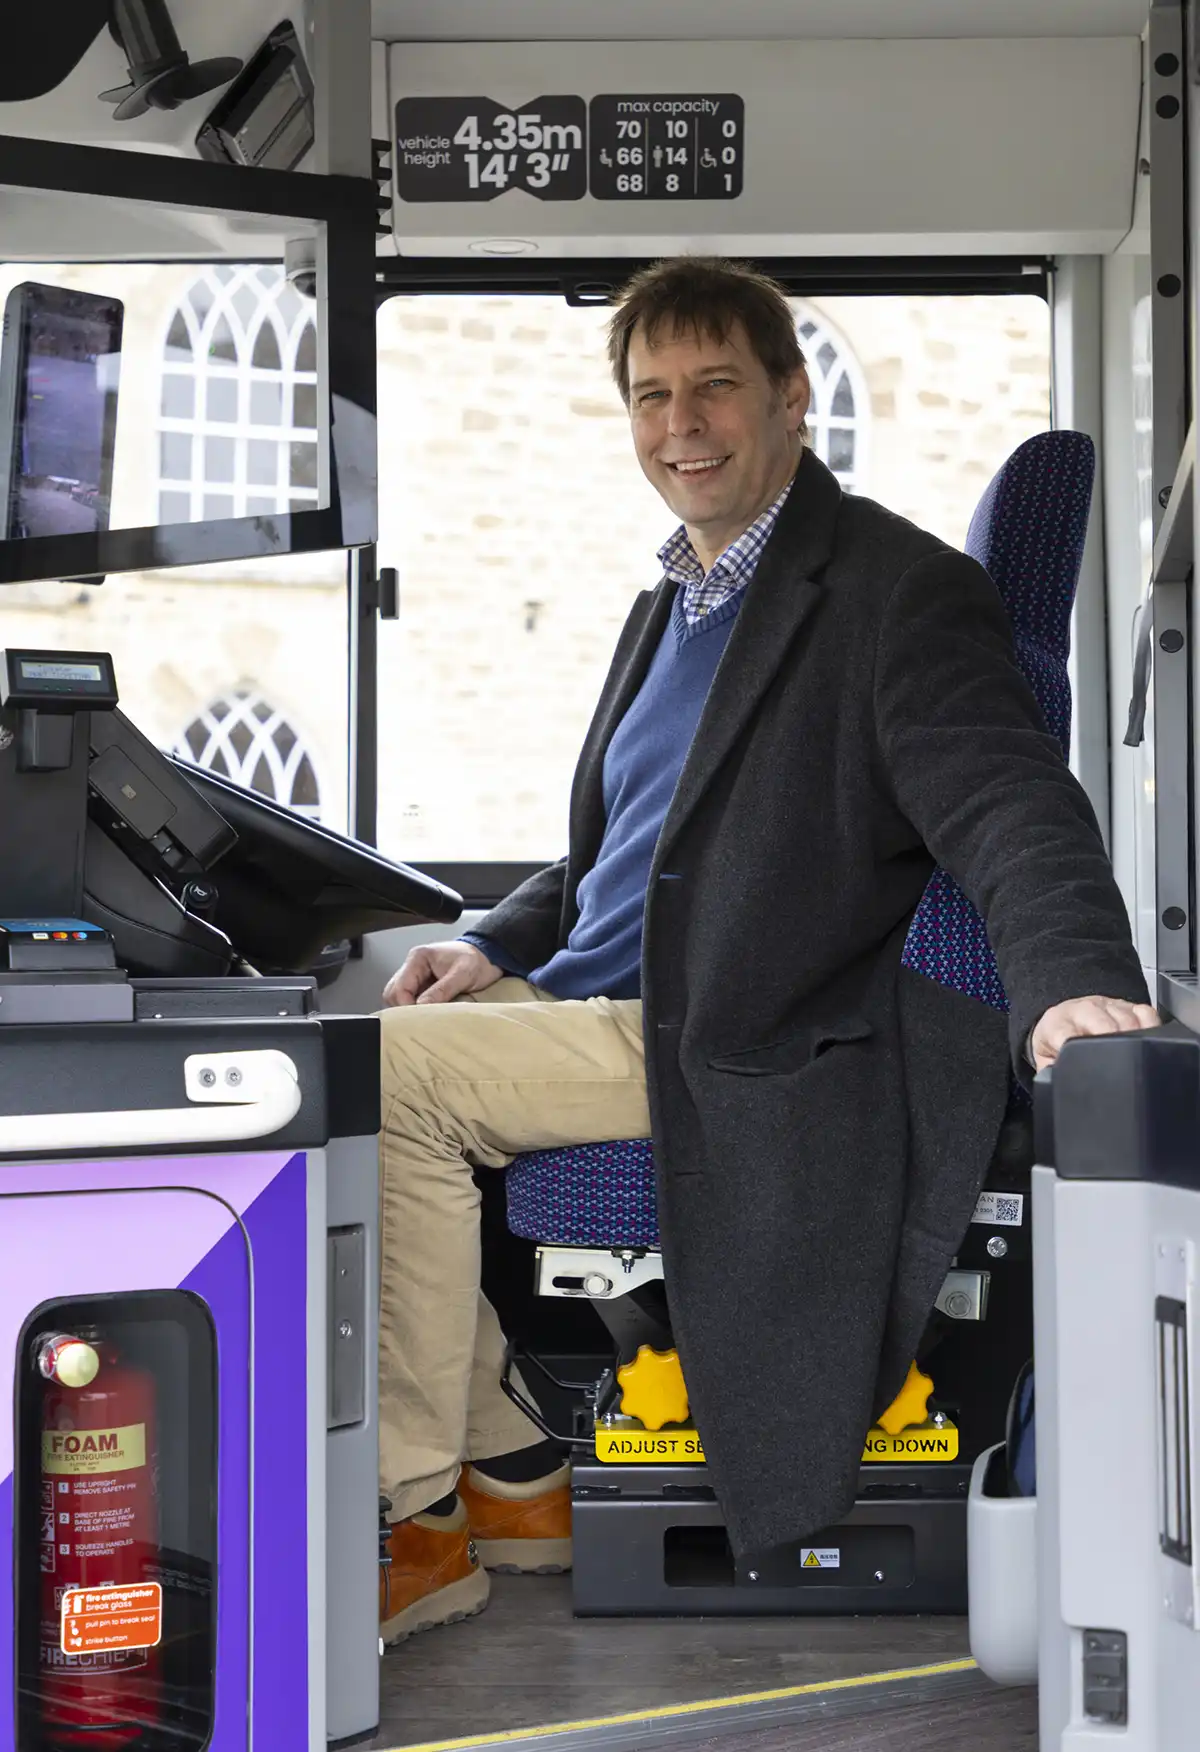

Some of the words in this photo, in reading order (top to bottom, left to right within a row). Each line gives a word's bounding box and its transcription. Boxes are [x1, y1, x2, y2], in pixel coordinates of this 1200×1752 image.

[617, 101, 650, 113] max
[653, 98, 720, 115] capacity
[453, 114, 582, 151] 4.35m
[616, 121, 641, 139] 70
[665, 120, 688, 139] 10
[722, 120, 736, 138] 0
[399, 136, 450, 151] vehicle
[404, 152, 451, 169] height
[616, 149, 643, 166] 66
[665, 148, 688, 166] 14
[722, 147, 736, 165] 0
[616, 174, 643, 193] 68
[665, 174, 680, 192] 8
[724, 174, 732, 192] 1
[52, 1433, 119, 1454] FOAM
[608, 1440, 679, 1454] ADJUST
[892, 1439, 949, 1453] DOWN
[64, 1450, 125, 1461] EXTINGUISHER
[86, 1594, 100, 1602] fire
[101, 1590, 154, 1601] extinguisher
[86, 1602, 109, 1611] break
[110, 1601, 133, 1611] glass
[120, 1617, 139, 1625] break
